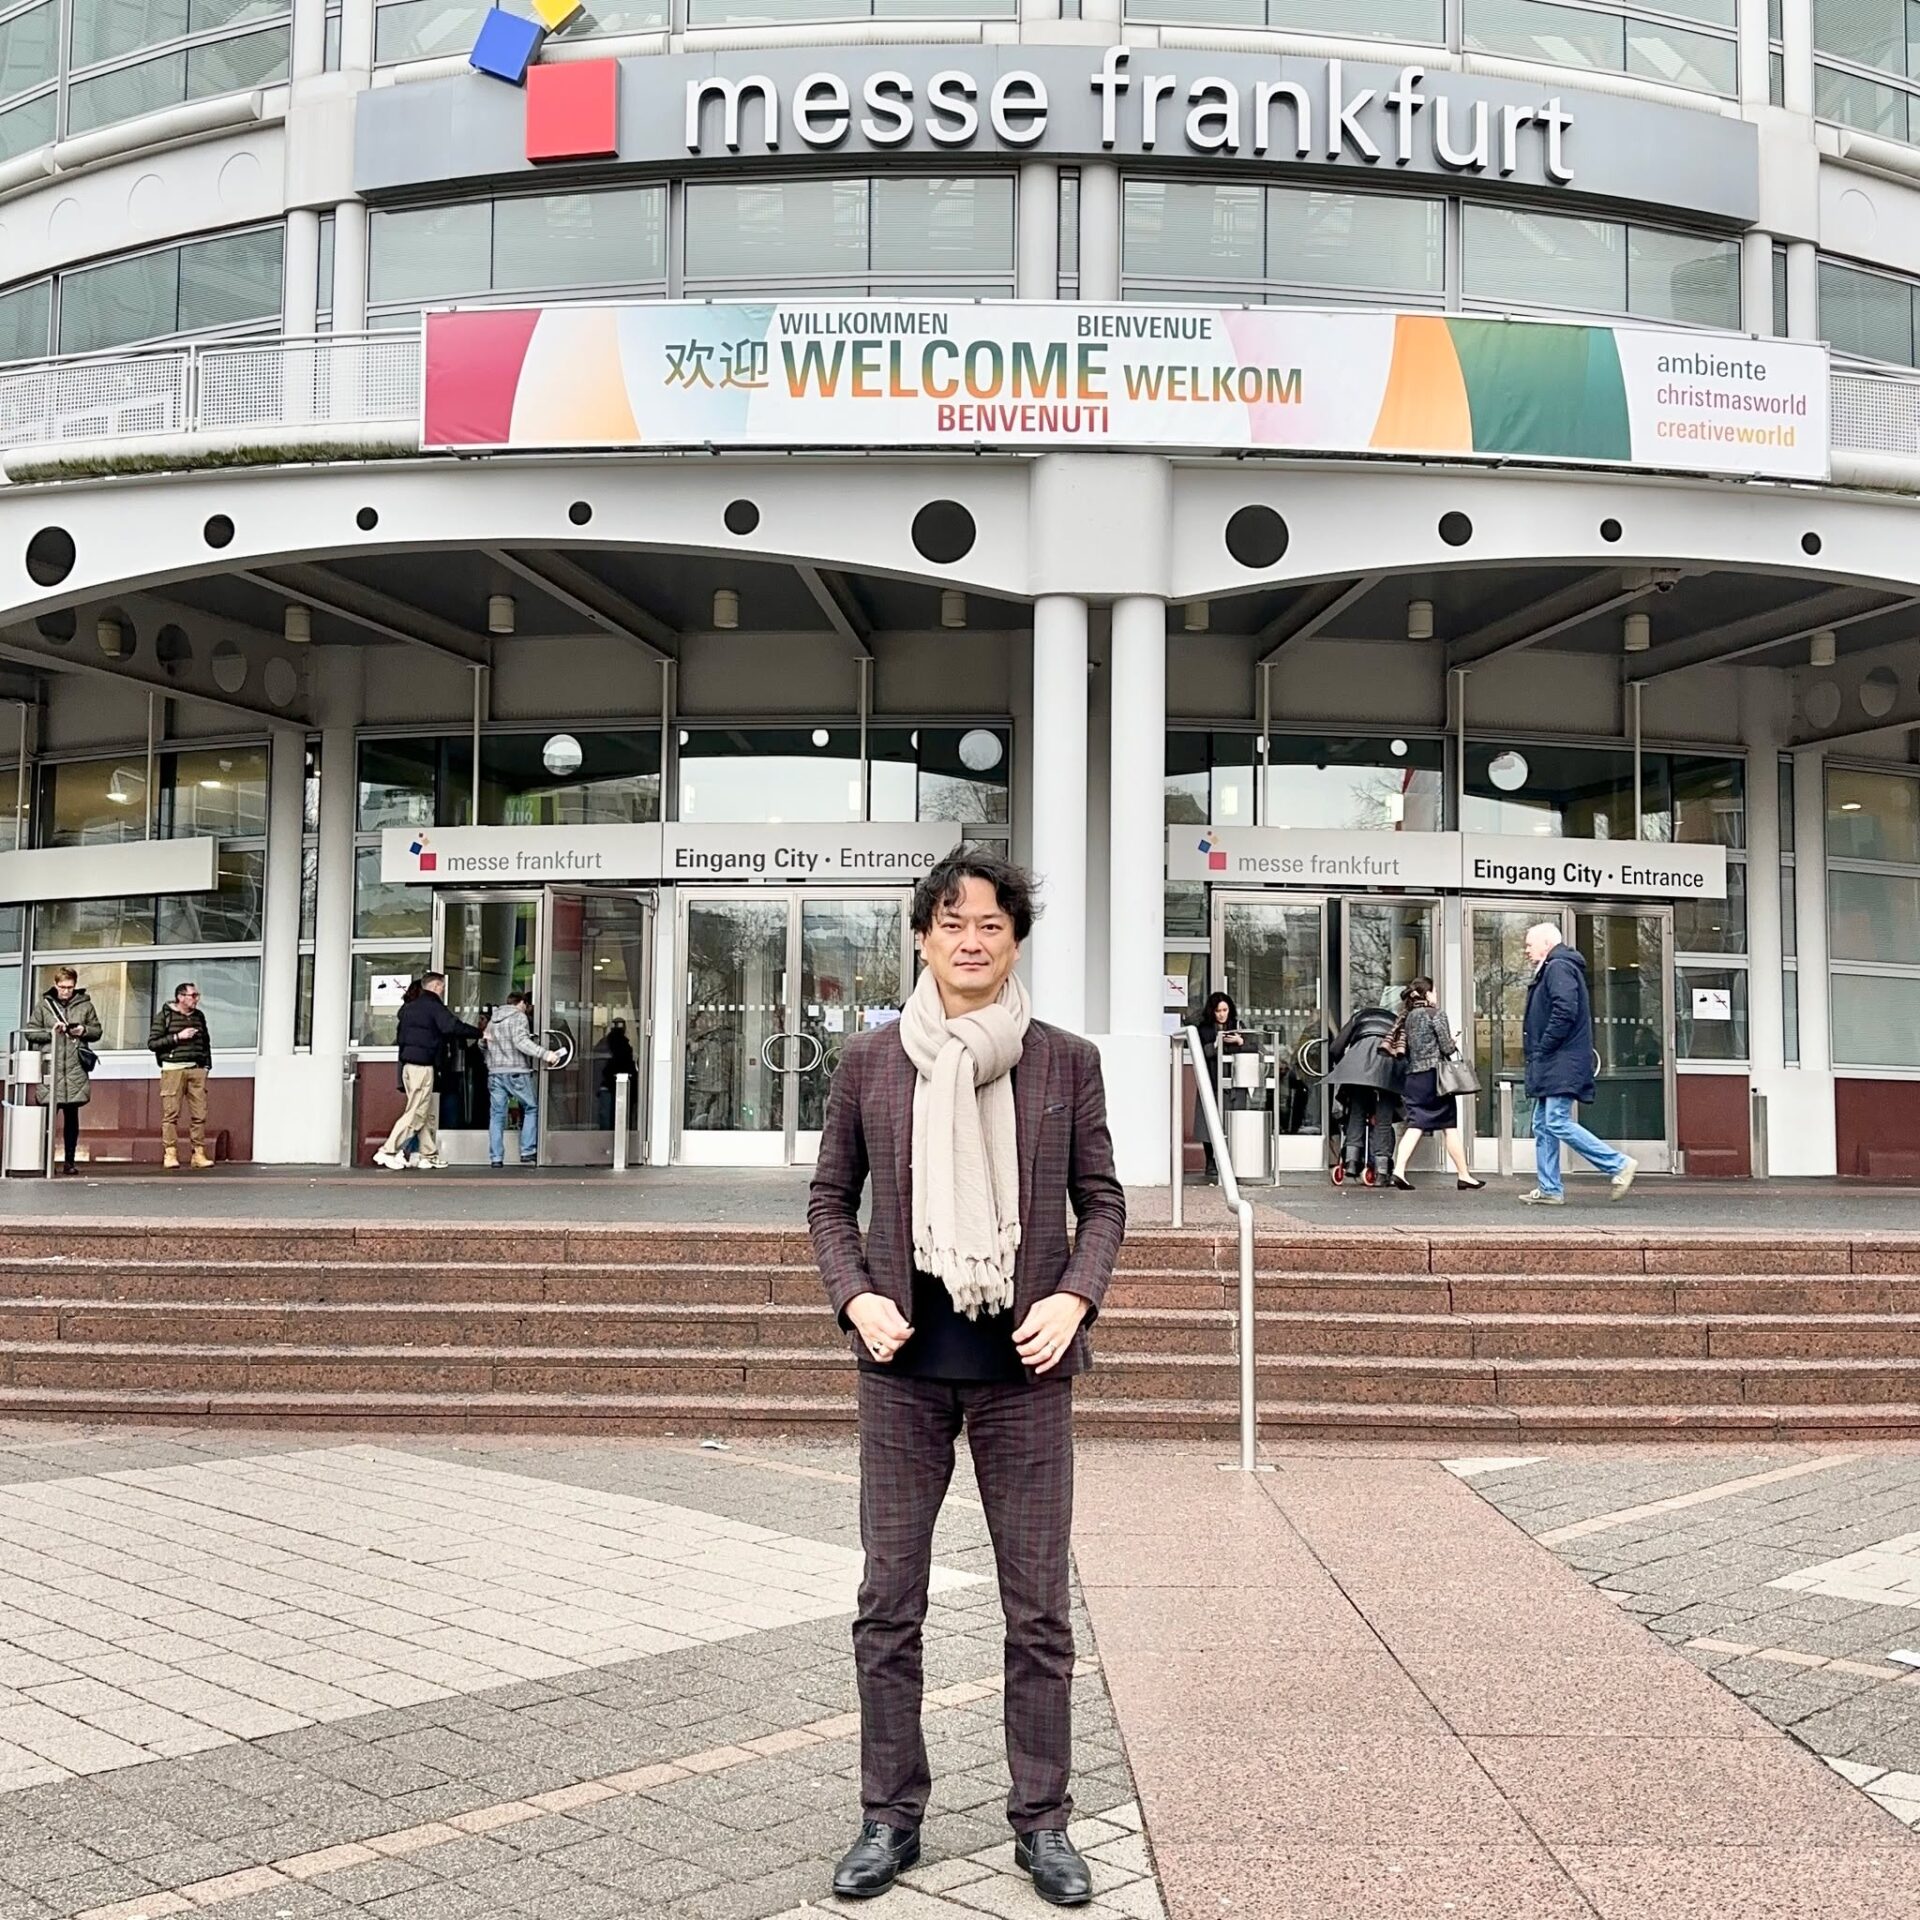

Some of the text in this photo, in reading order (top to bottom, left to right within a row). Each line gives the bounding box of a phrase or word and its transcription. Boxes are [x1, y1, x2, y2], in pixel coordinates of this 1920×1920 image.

[685, 45, 1576, 185] messe frankfurt
[780, 312, 949, 341] WILLKOMMEN
[1077, 315, 1212, 341] BIENVENUE
[664, 337, 770, 391] 欢迎
[781, 339, 1109, 400] WELCOME
[1657, 352, 1767, 381] ambiente
[1124, 363, 1303, 405] WELKOM
[1657, 383, 1807, 416] christmasworld
[938, 404, 1109, 433] BENVENUTI
[1657, 419, 1796, 448] creativeworld
[447, 850, 602, 871] messe frankfurt
[674, 848, 936, 873] Eingang City Entrance
[1238, 854, 1400, 875] messe frankfurt
[1473, 858, 1704, 888] Eingang City Entrance
